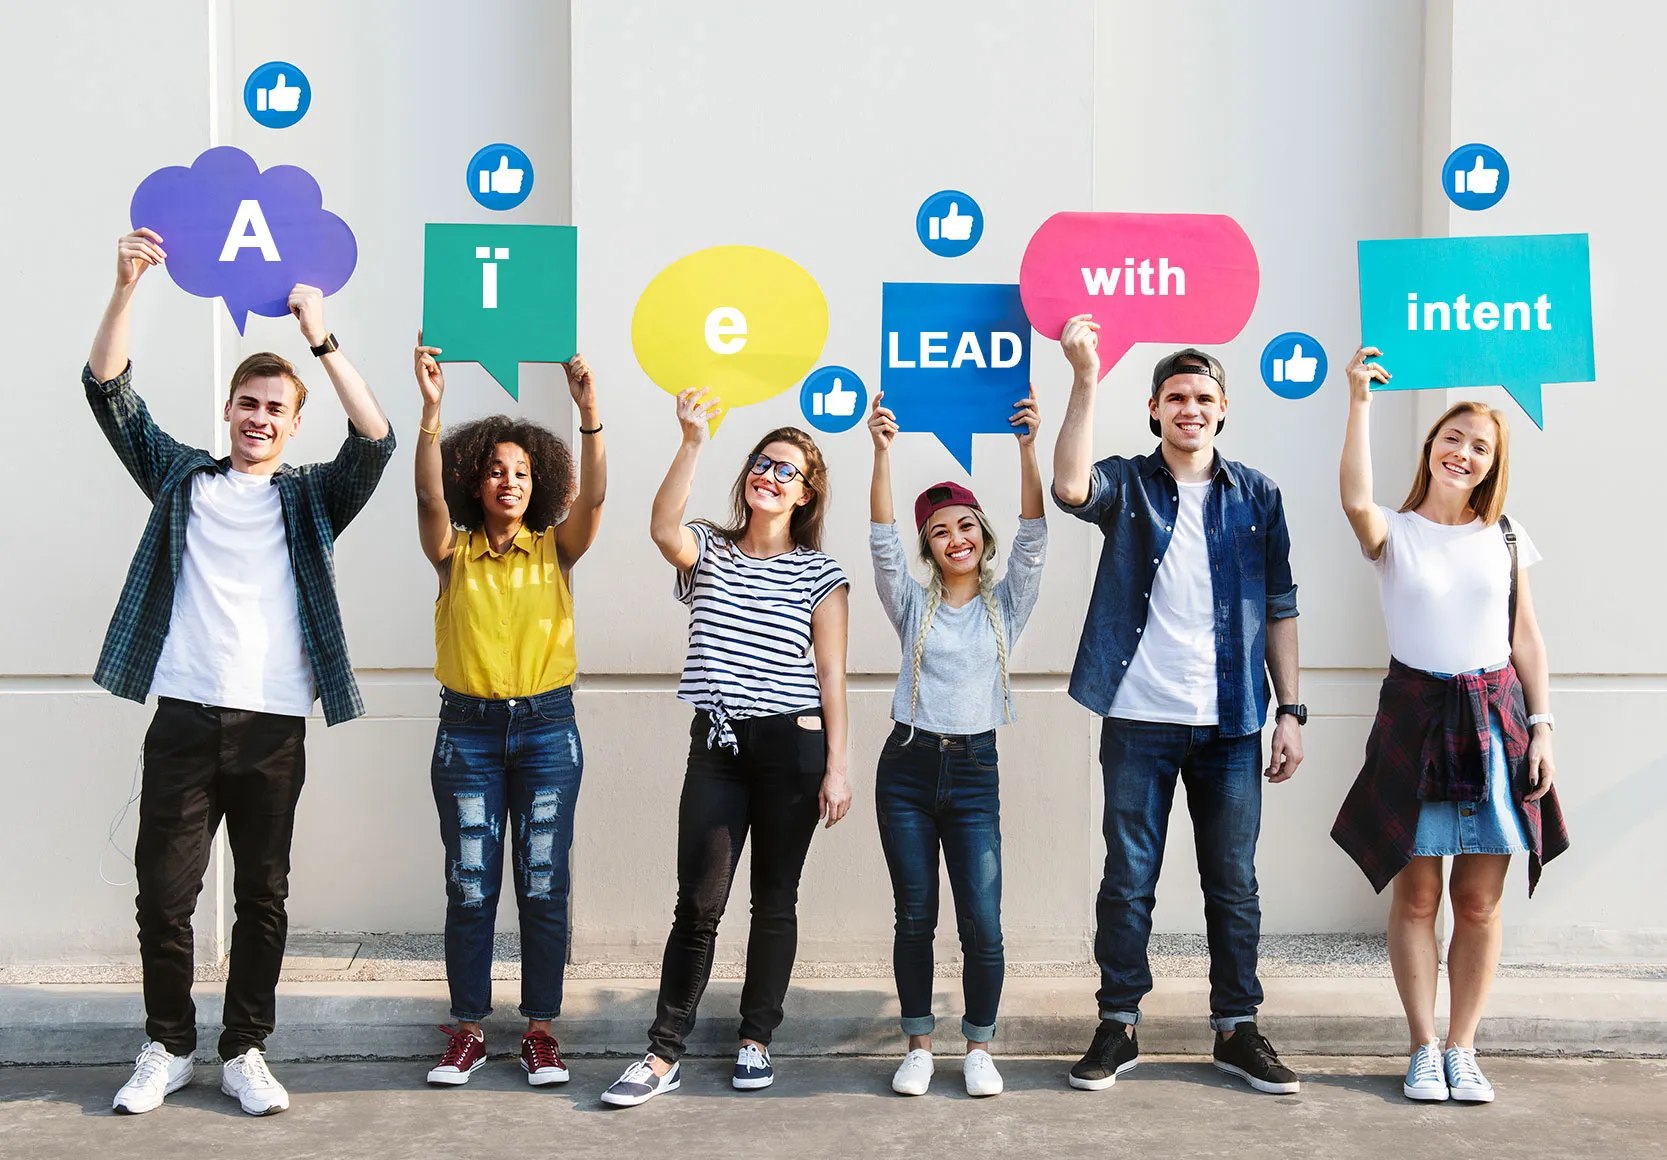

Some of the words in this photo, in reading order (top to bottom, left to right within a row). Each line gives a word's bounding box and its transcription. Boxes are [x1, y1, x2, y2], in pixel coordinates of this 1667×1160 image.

[218, 199, 282, 262] A
[1080, 257, 1186, 297] with
[704, 306, 748, 355] e
[1407, 292, 1553, 332] intent
[887, 331, 1023, 369] LEAD
